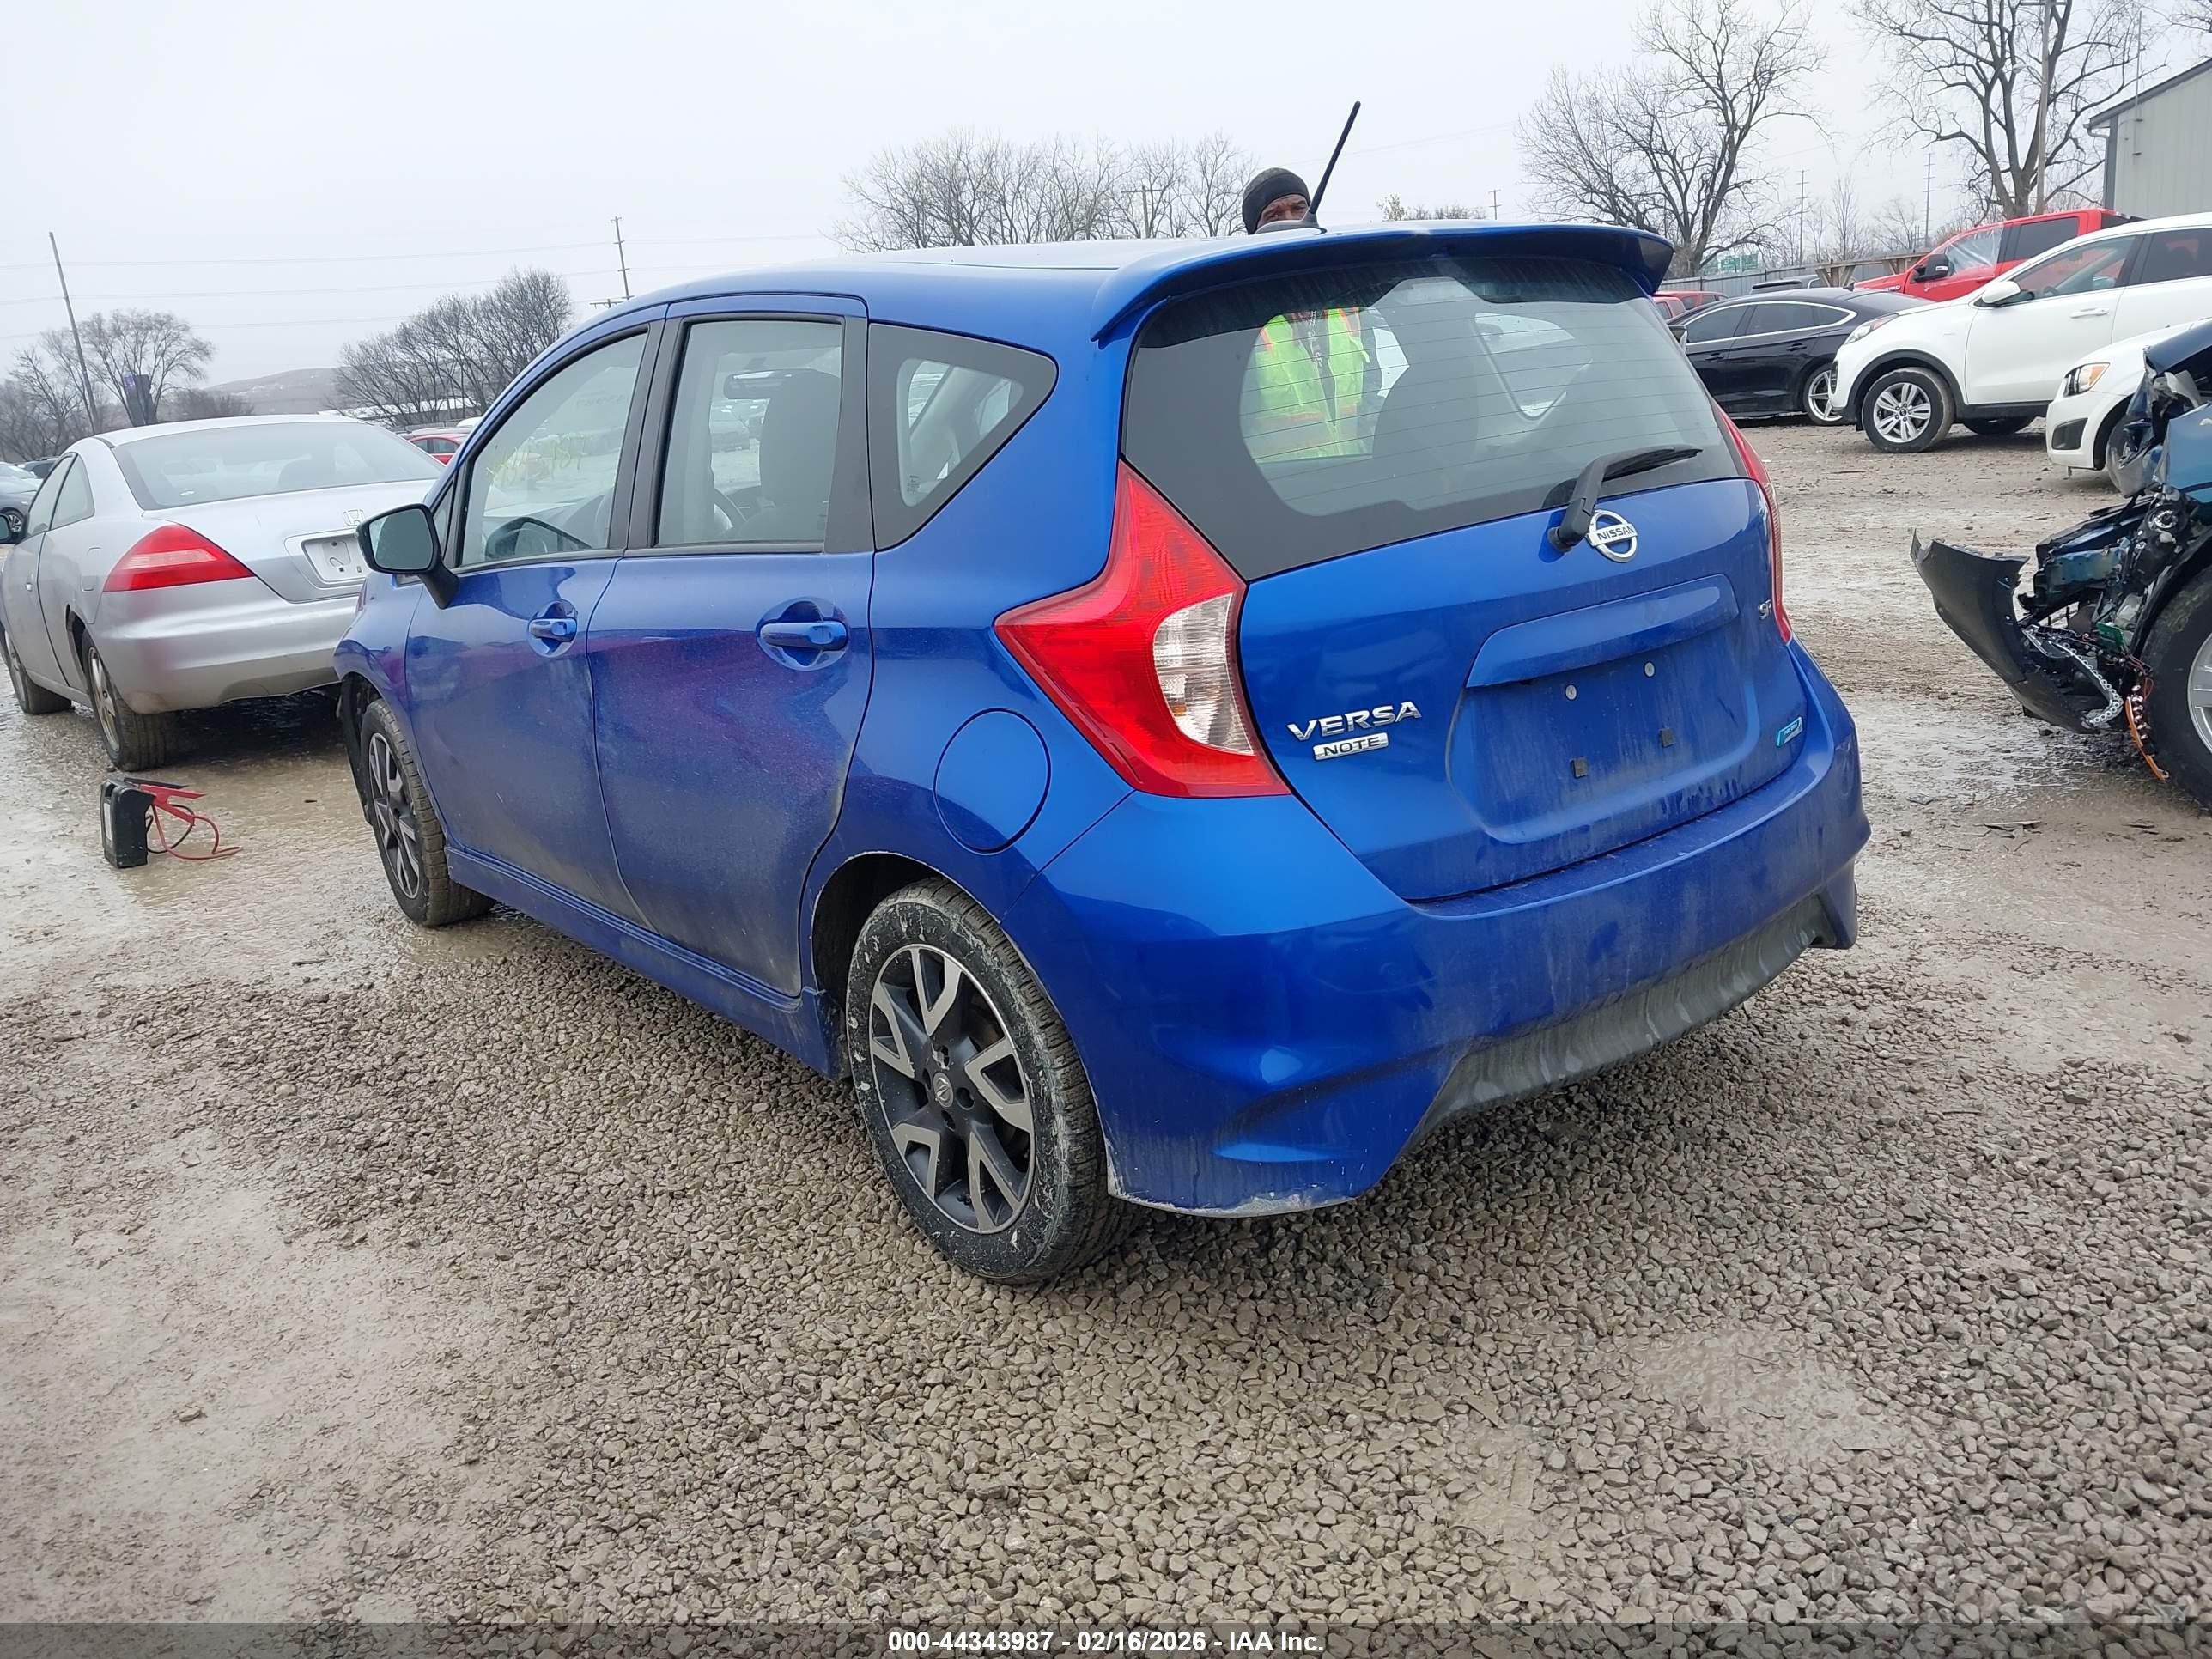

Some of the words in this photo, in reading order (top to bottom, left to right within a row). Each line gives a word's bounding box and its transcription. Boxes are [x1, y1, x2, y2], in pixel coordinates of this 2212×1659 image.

[1596, 525, 1635, 542] NISSAN
[1286, 701, 1422, 741] VERSA
[1322, 736, 1382, 757] NOTE
